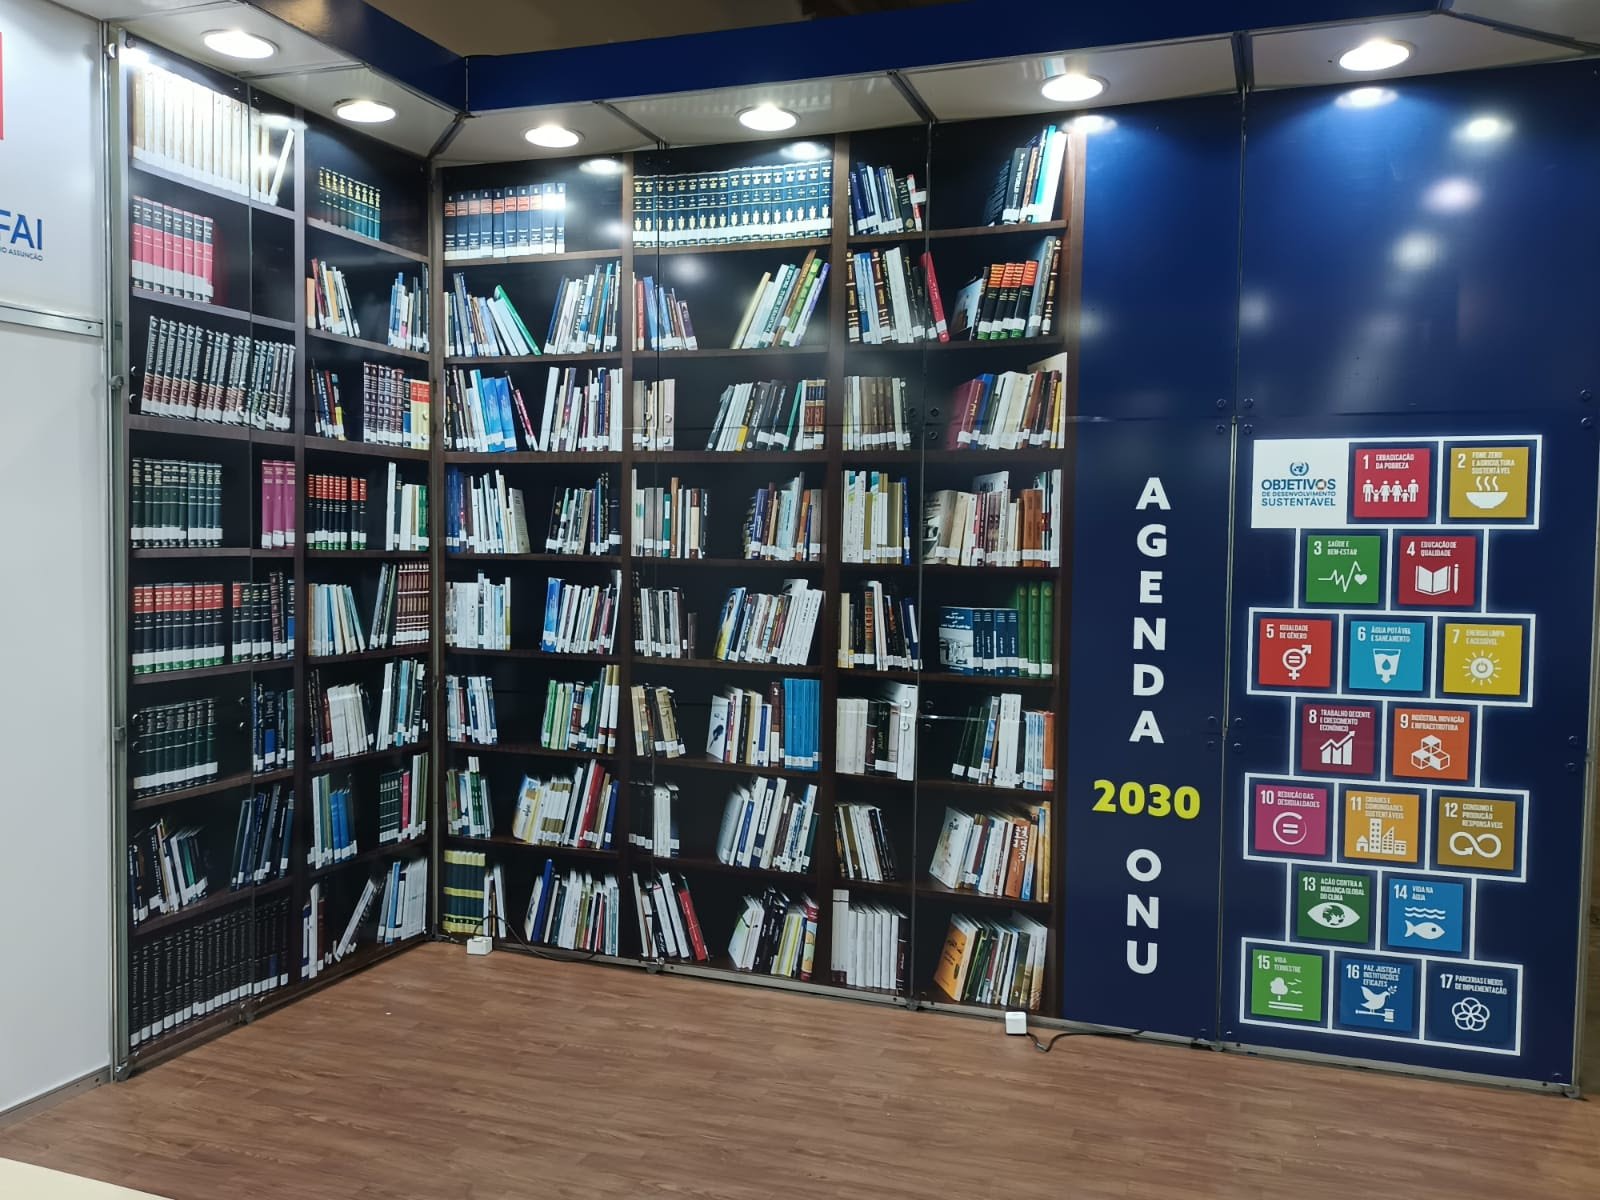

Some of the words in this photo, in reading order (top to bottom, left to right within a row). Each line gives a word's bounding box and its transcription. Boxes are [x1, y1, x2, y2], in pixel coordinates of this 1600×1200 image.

[1363, 454, 1369, 470] 1
[1458, 453, 1466, 468] 2
[1261, 479, 1336, 490] OBJETIVOS
[1314, 540, 1322, 556] 3
[1406, 541, 1416, 556] 4
[1129, 477, 1171, 744] AGENDA
[1266, 624, 1274, 638] 5
[1358, 626, 1366, 642] 6
[1452, 629, 1460, 644] 7
[1309, 709, 1318, 724] 8
[1400, 714, 1408, 728] 9
[1092, 779, 1200, 820] 2030
[1260, 790, 1274, 804] 10
[1278, 790, 1302, 798] REDUÇÃO
[1351, 796, 1362, 811] 11
[1444, 802, 1458, 818] 12
[1302, 876, 1316, 891] 13
[1394, 884, 1408, 900] 14
[1126, 849, 1162, 974] ONU
[1257, 954, 1270, 970] 15
[1346, 964, 1360, 979] 16
[1440, 974, 1454, 988] 17
